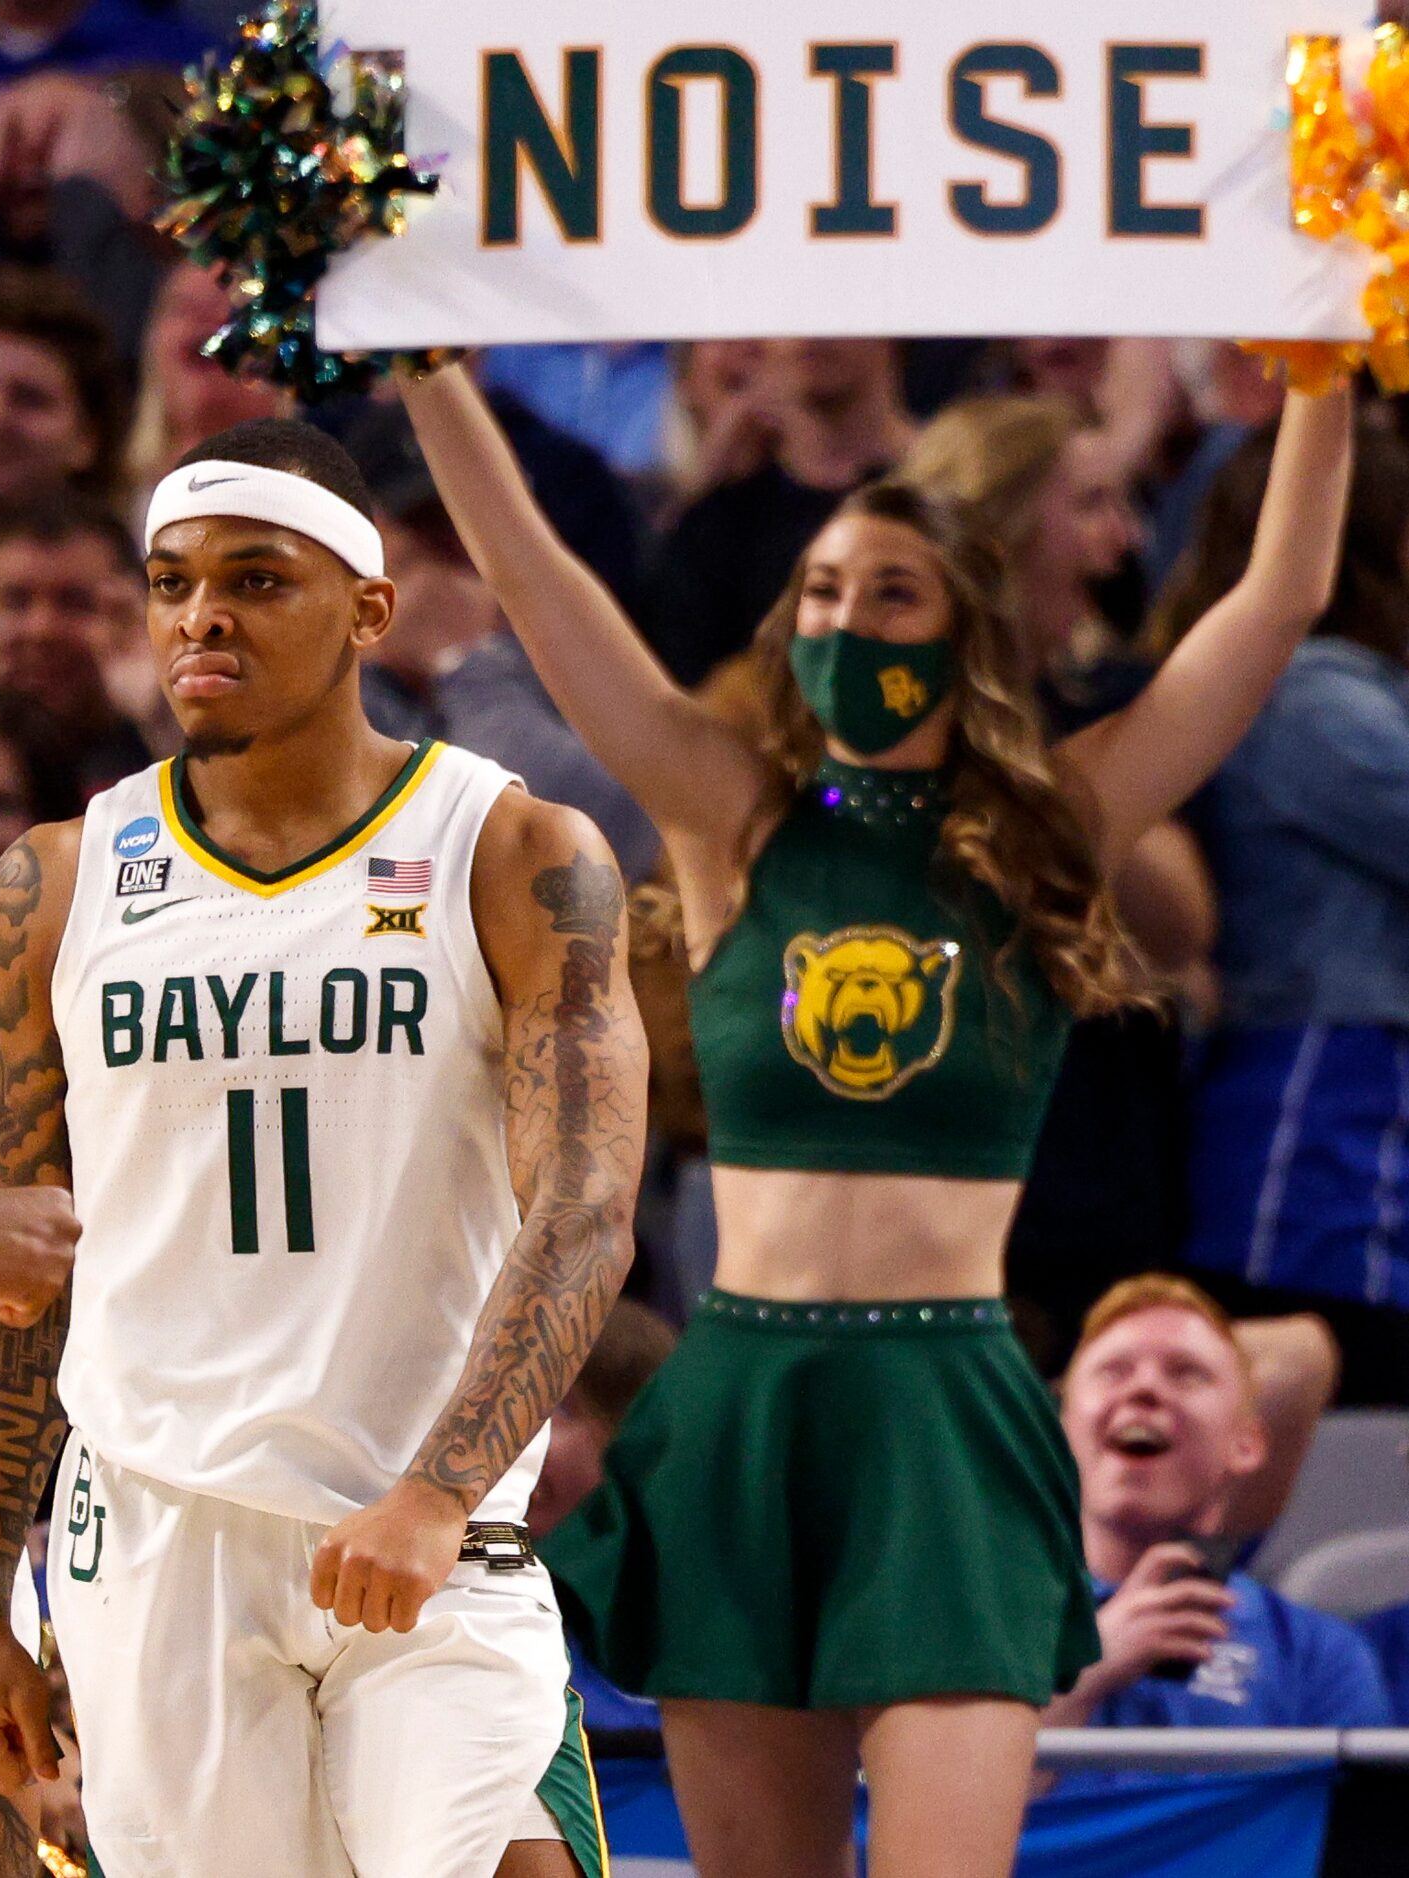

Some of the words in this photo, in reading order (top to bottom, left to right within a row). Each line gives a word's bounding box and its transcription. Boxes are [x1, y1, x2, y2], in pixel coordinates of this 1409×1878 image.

[478, 41, 1207, 247] NOISE
[119, 832, 155, 849] NCAA
[121, 860, 168, 886] ONE
[102, 968, 428, 1068] BAYLOR
[227, 1087, 315, 1254] 11
